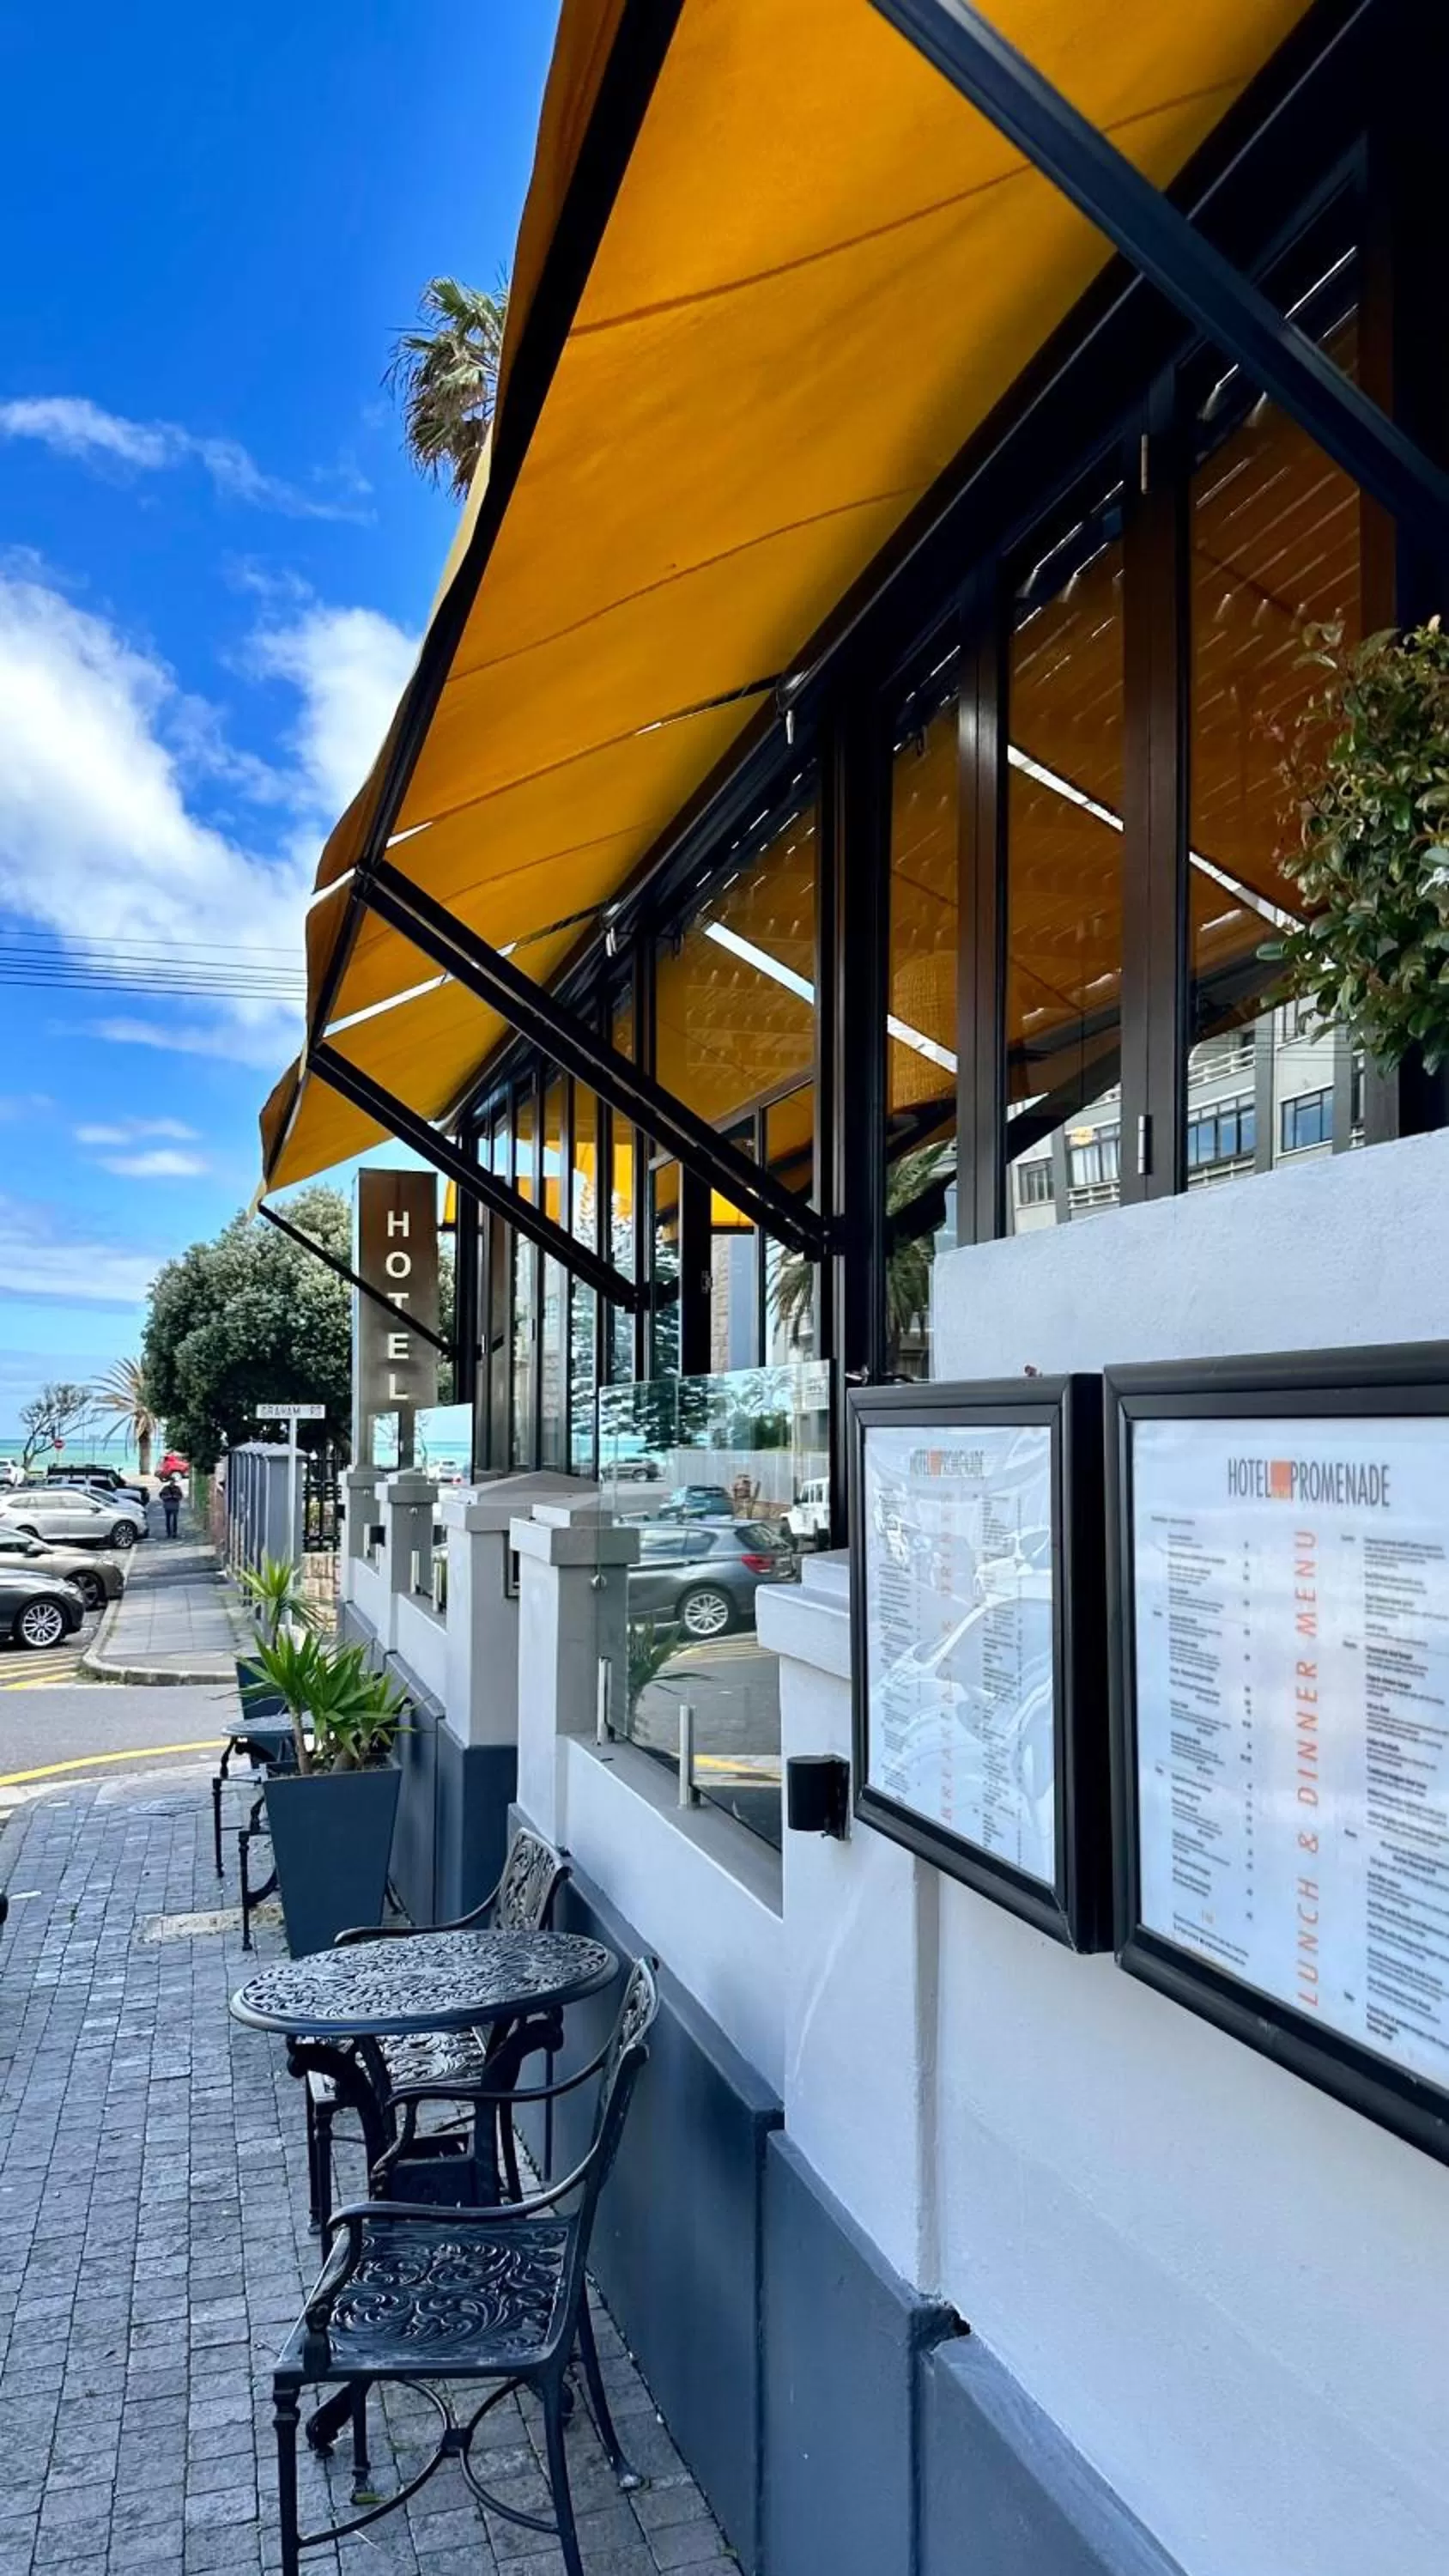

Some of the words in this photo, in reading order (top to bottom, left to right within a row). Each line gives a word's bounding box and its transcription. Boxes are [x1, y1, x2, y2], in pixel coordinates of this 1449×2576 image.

[386, 1210, 412, 1401] HOTEL
[1228, 1458, 1272, 1498] HOTEL
[1290, 1460, 1391, 1508] PROMENADE
[1294, 1530, 1317, 1638] MENU
[1295, 1661, 1319, 1807] DINNER
[1297, 1832, 1319, 1855] &
[1297, 1876, 1319, 2007] LUNCH
